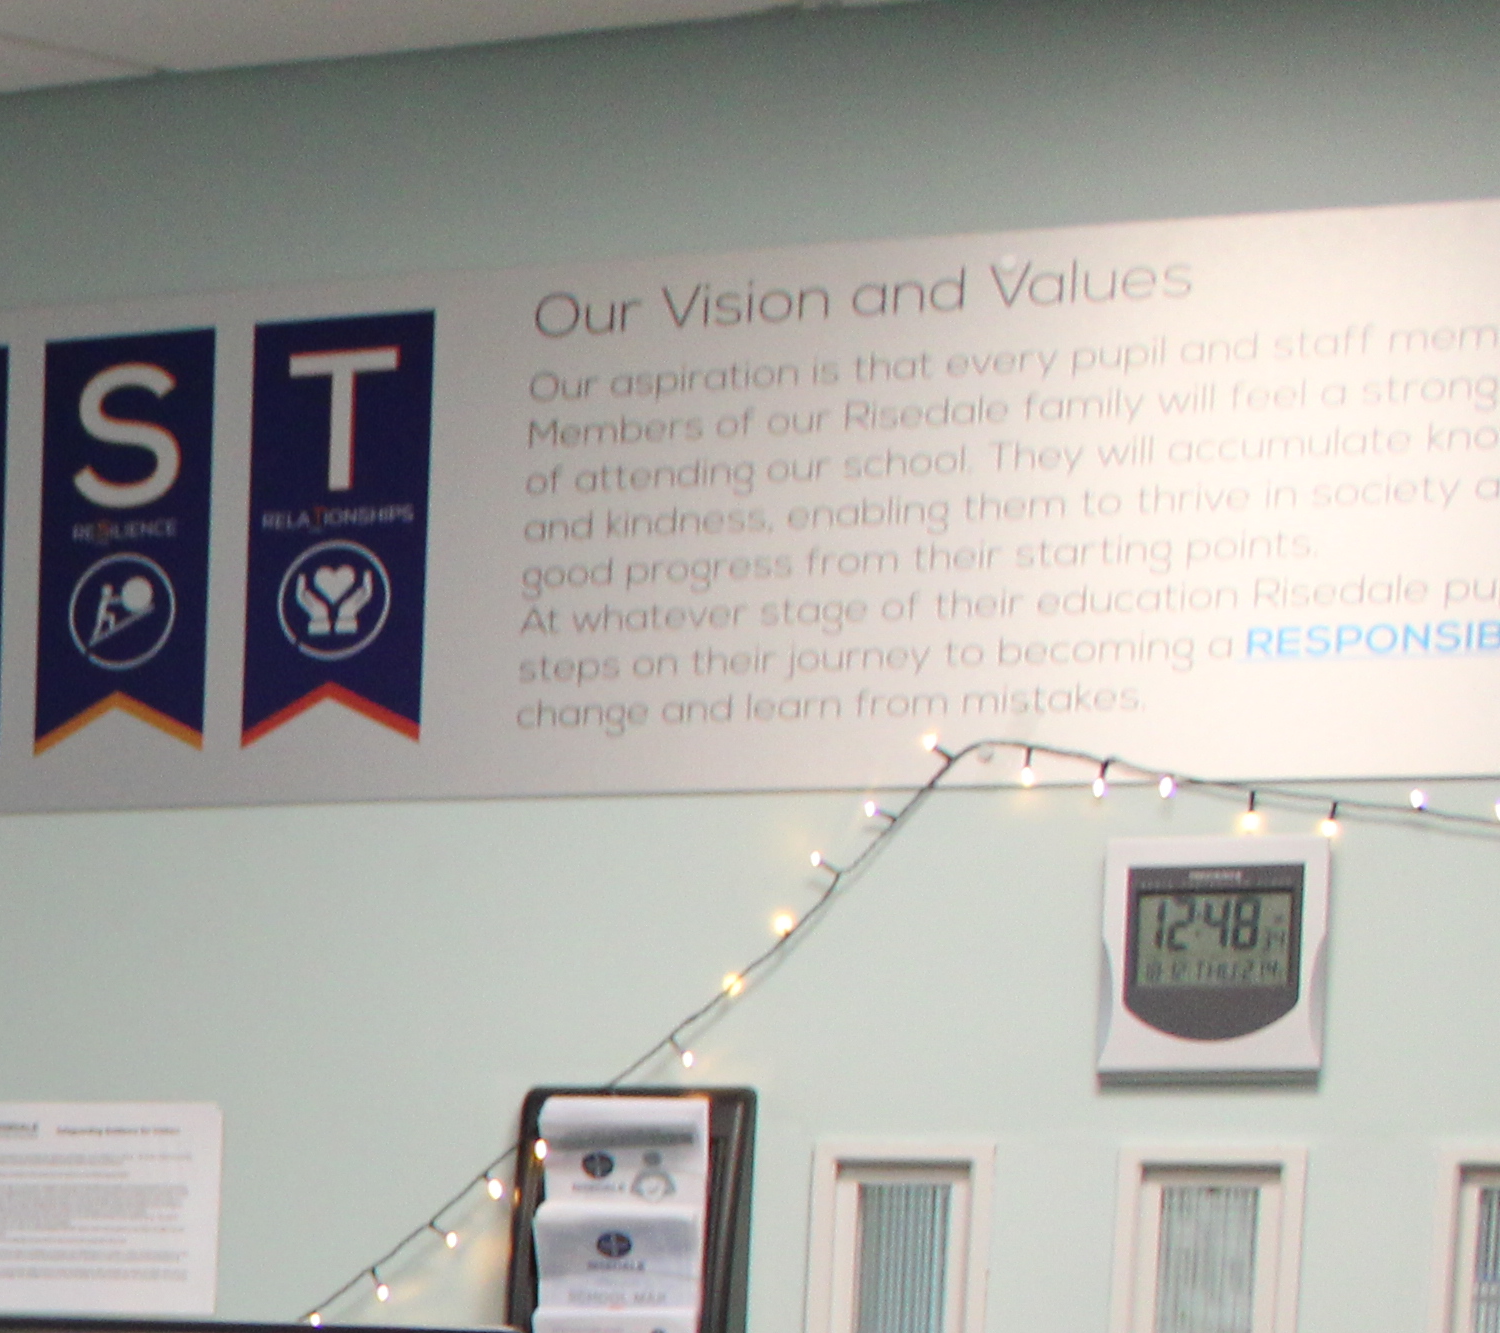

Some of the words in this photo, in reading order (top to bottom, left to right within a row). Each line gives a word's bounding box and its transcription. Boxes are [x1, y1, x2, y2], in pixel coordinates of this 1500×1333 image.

[534, 291, 642, 338] Our
[661, 281, 830, 329] Vision
[852, 265, 966, 317] and
[990, 258, 1192, 308] Values
[529, 371, 599, 402] Our
[610, 362, 799, 402] aspiration
[812, 356, 839, 386] is
[856, 350, 932, 383] that
[947, 349, 1058, 380] every
[1072, 336, 1167, 378] pupil
[1180, 331, 1259, 364] and
[1273, 322, 1374, 359] staff
[1389, 324, 1499, 354] mem
[74, 361, 181, 509] S
[289, 344, 401, 491] T
[528, 416, 703, 449] Members
[716, 406, 755, 439] of
[767, 408, 831, 435] our
[844, 395, 1008, 431] Risedale
[1026, 389, 1144, 425] family
[1158, 381, 1215, 414] will
[1231, 378, 1307, 411] feel
[1321, 383, 1347, 407] a
[1363, 374, 1499, 412] strong
[526, 463, 562, 496] of
[575, 458, 754, 498] attending
[767, 456, 831, 484] our
[844, 445, 974, 479] school.
[990, 438, 1084, 476] They
[1097, 434, 1155, 467] will
[1169, 426, 1412, 462] accumulate
[1427, 420, 1499, 451] kno
[524, 509, 594, 542] and
[606, 505, 774, 539] kindness,
[788, 495, 949, 535] enabling
[965, 493, 1066, 522] them
[1083, 488, 1122, 518] to
[1139, 482, 1250, 515] thrive
[1266, 480, 1298, 510] in
[1312, 474, 1461, 511] society
[522, 556, 614, 600] good
[626, 554, 793, 594] progress
[809, 548, 898, 576] from
[915, 539, 1002, 573] their
[1016, 534, 1172, 574] starting
[1186, 529, 1318, 570] points.
[521, 605, 559, 636] At
[572, 602, 750, 634] whatever
[760, 597, 867, 636] stage
[881, 588, 921, 622] of
[936, 587, 1024, 621] their
[1036, 578, 1239, 617] education
[1253, 571, 1430, 611] Risedale
[518, 655, 621, 688] steps
[632, 654, 679, 678] on
[693, 647, 771, 676] their
[787, 640, 931, 682] journey
[946, 641, 984, 668] to
[998, 630, 1195, 673] becoming
[1208, 636, 1233, 659] a
[1246, 618, 1499, 658] RESPONSIB
[516, 698, 649, 737] change
[662, 693, 734, 724] and
[747, 692, 842, 722] learn
[857, 688, 949, 717] from
[962, 681, 1146, 715] mistakes.
[1155, 894, 1262, 951] 12:48
